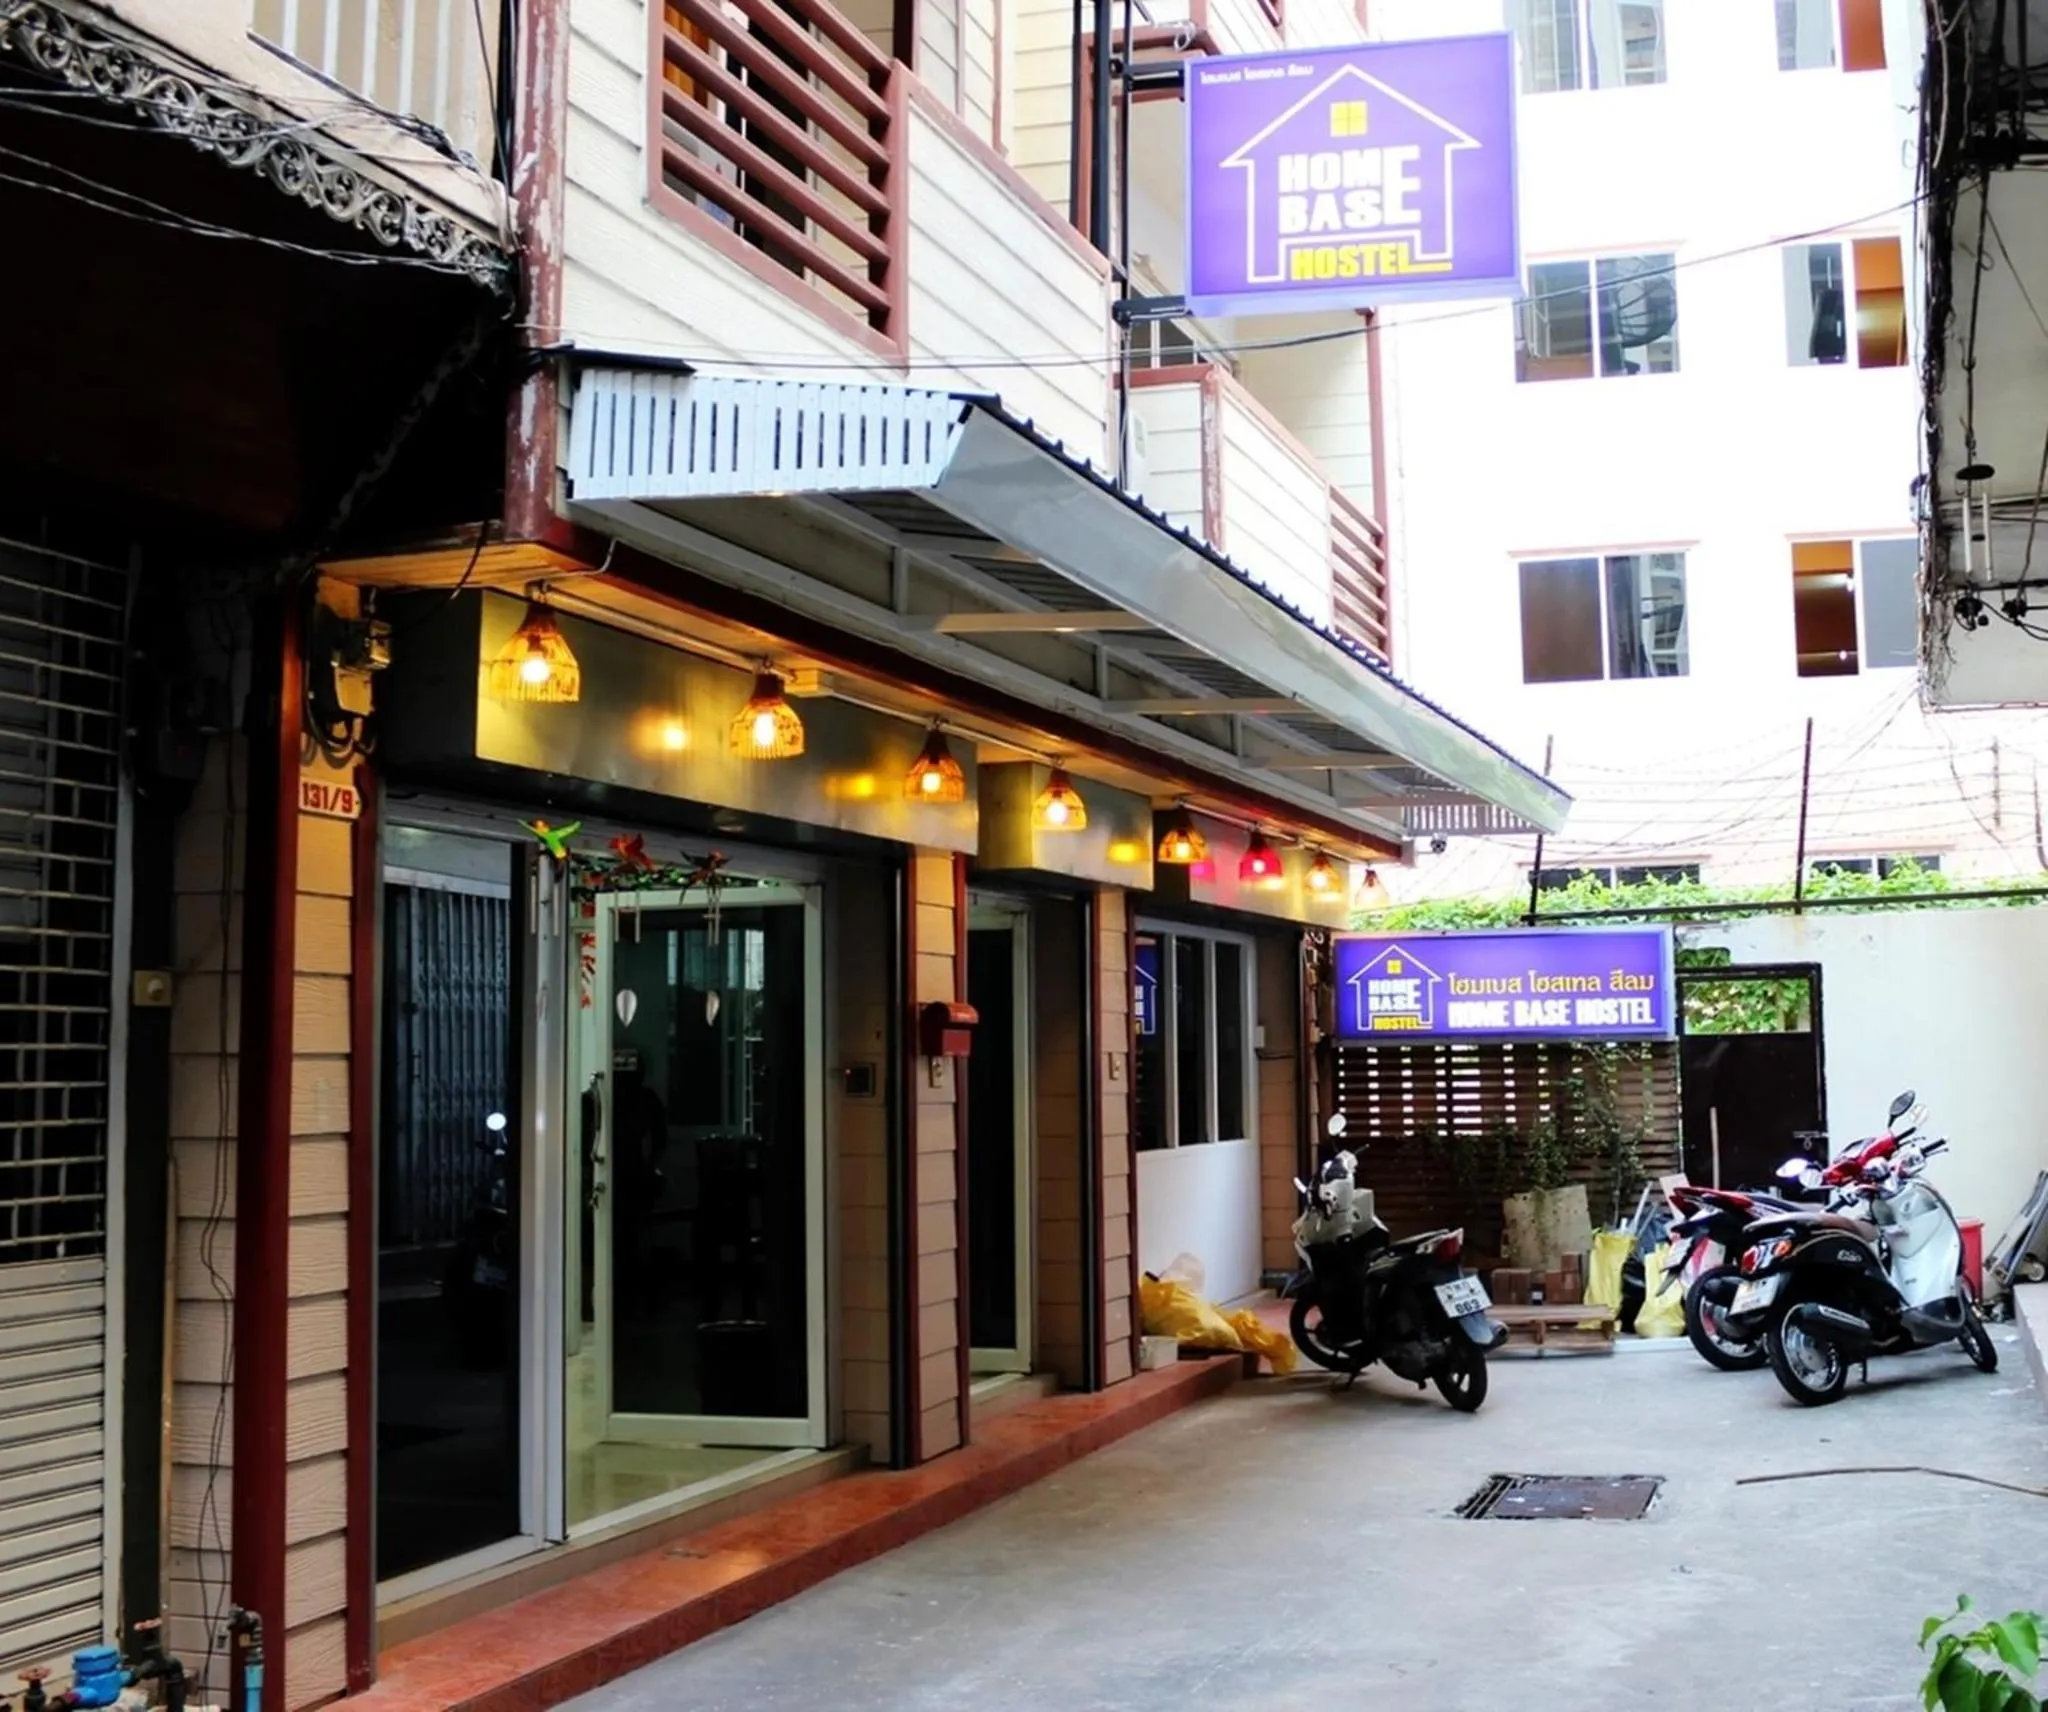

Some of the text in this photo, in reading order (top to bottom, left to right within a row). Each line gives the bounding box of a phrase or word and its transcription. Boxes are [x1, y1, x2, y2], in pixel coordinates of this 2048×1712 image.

[1278, 145, 1421, 200] HOME
[1278, 180, 1422, 234] BASE
[1291, 242, 1452, 281] HOSTEL
[302, 781, 354, 814] 131/9
[1367, 977, 1421, 998] HOME
[1609, 968, 1655, 992] สีลม
[1367, 991, 1421, 1012] BASE
[1447, 997, 1656, 1028] HOME BASE HOSTEL
[1373, 1015, 1432, 1031] HOSTEL
